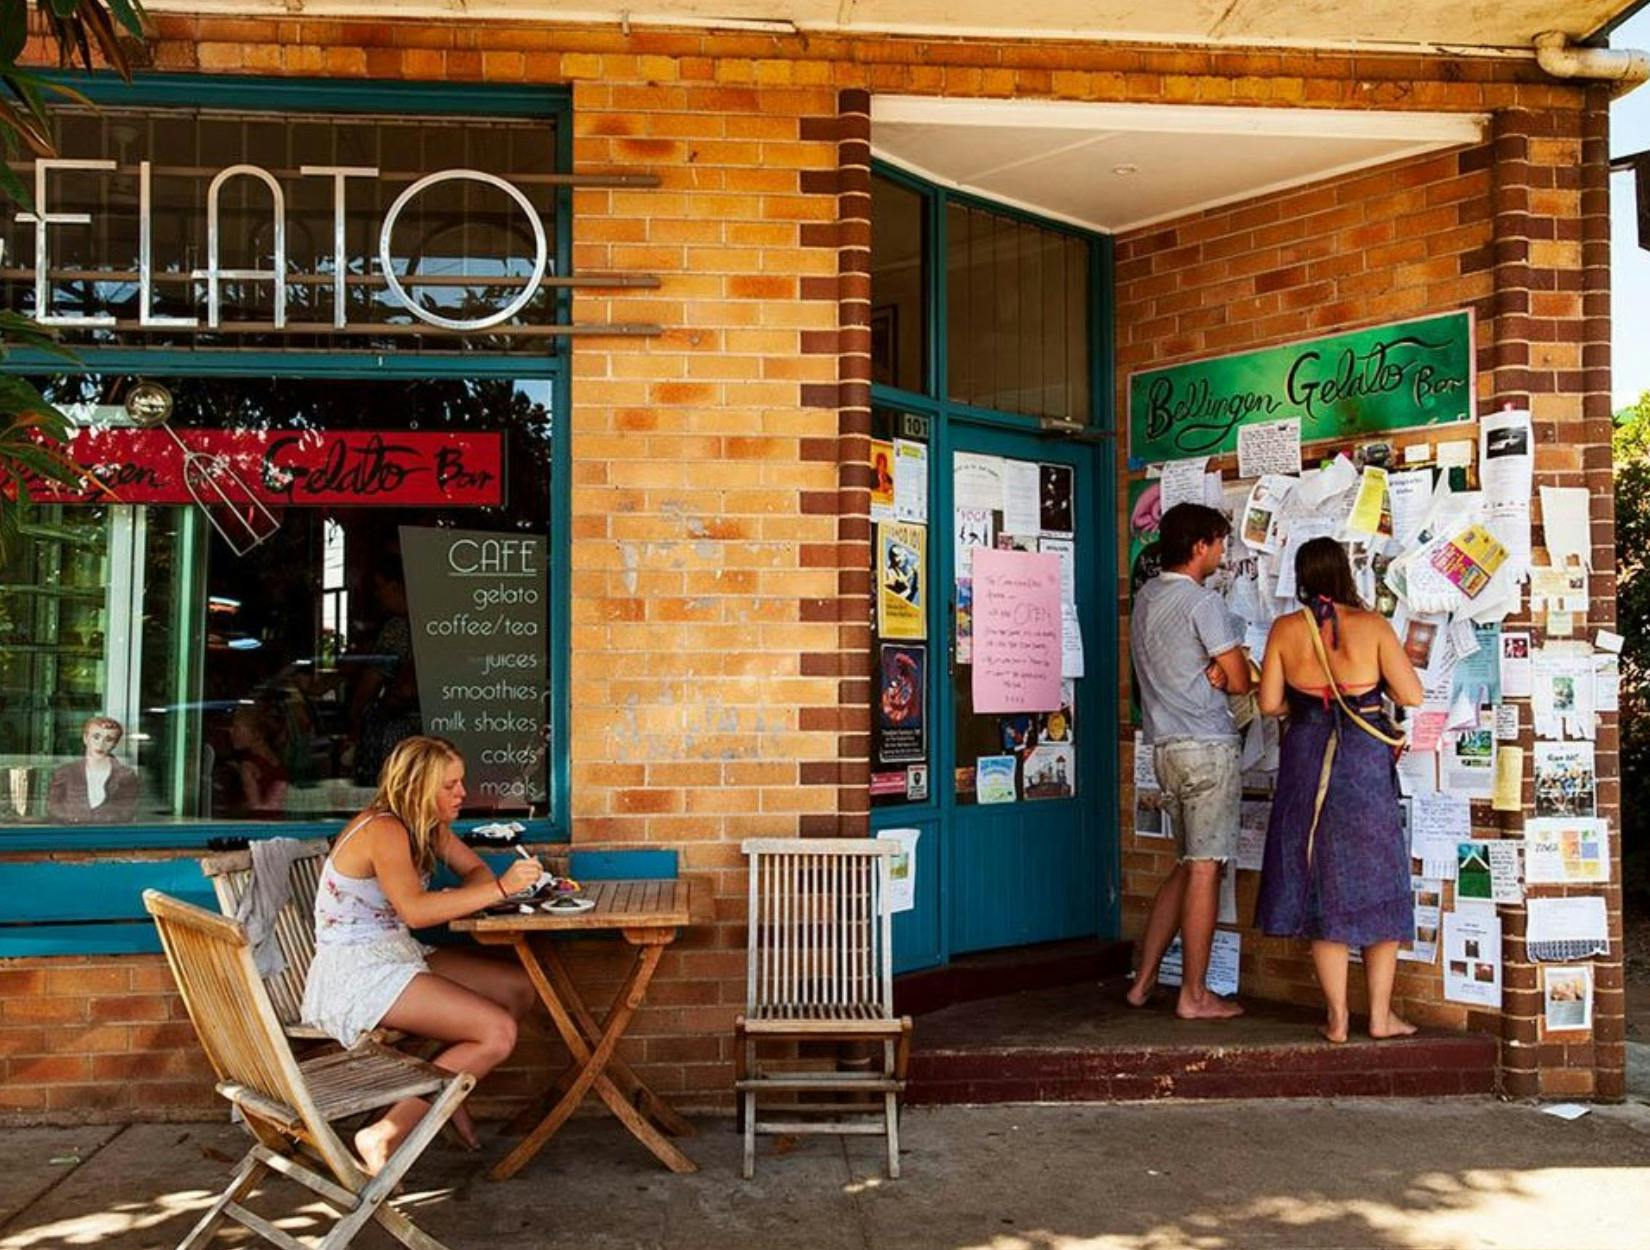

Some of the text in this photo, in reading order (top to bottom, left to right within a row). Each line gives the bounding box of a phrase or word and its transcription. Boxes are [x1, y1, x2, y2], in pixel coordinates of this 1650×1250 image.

[0, 158, 547, 329] ELATO
[1145, 375, 1283, 452] Bellingen
[1286, 336, 1455, 423] Gelato
[1412, 365, 1464, 408] Bar
[906, 418, 928, 435] 101
[262, 435, 493, 502] Gelato Bar
[448, 539, 537, 574] CAFE
[473, 583, 539, 610] gelato
[426, 613, 537, 637] coffee/tea
[481, 652, 537, 675] juices
[442, 680, 537, 701] smoothies
[431, 711, 537, 732] milk shakes
[481, 743, 537, 764] cakes
[480, 776, 537, 797] meals
